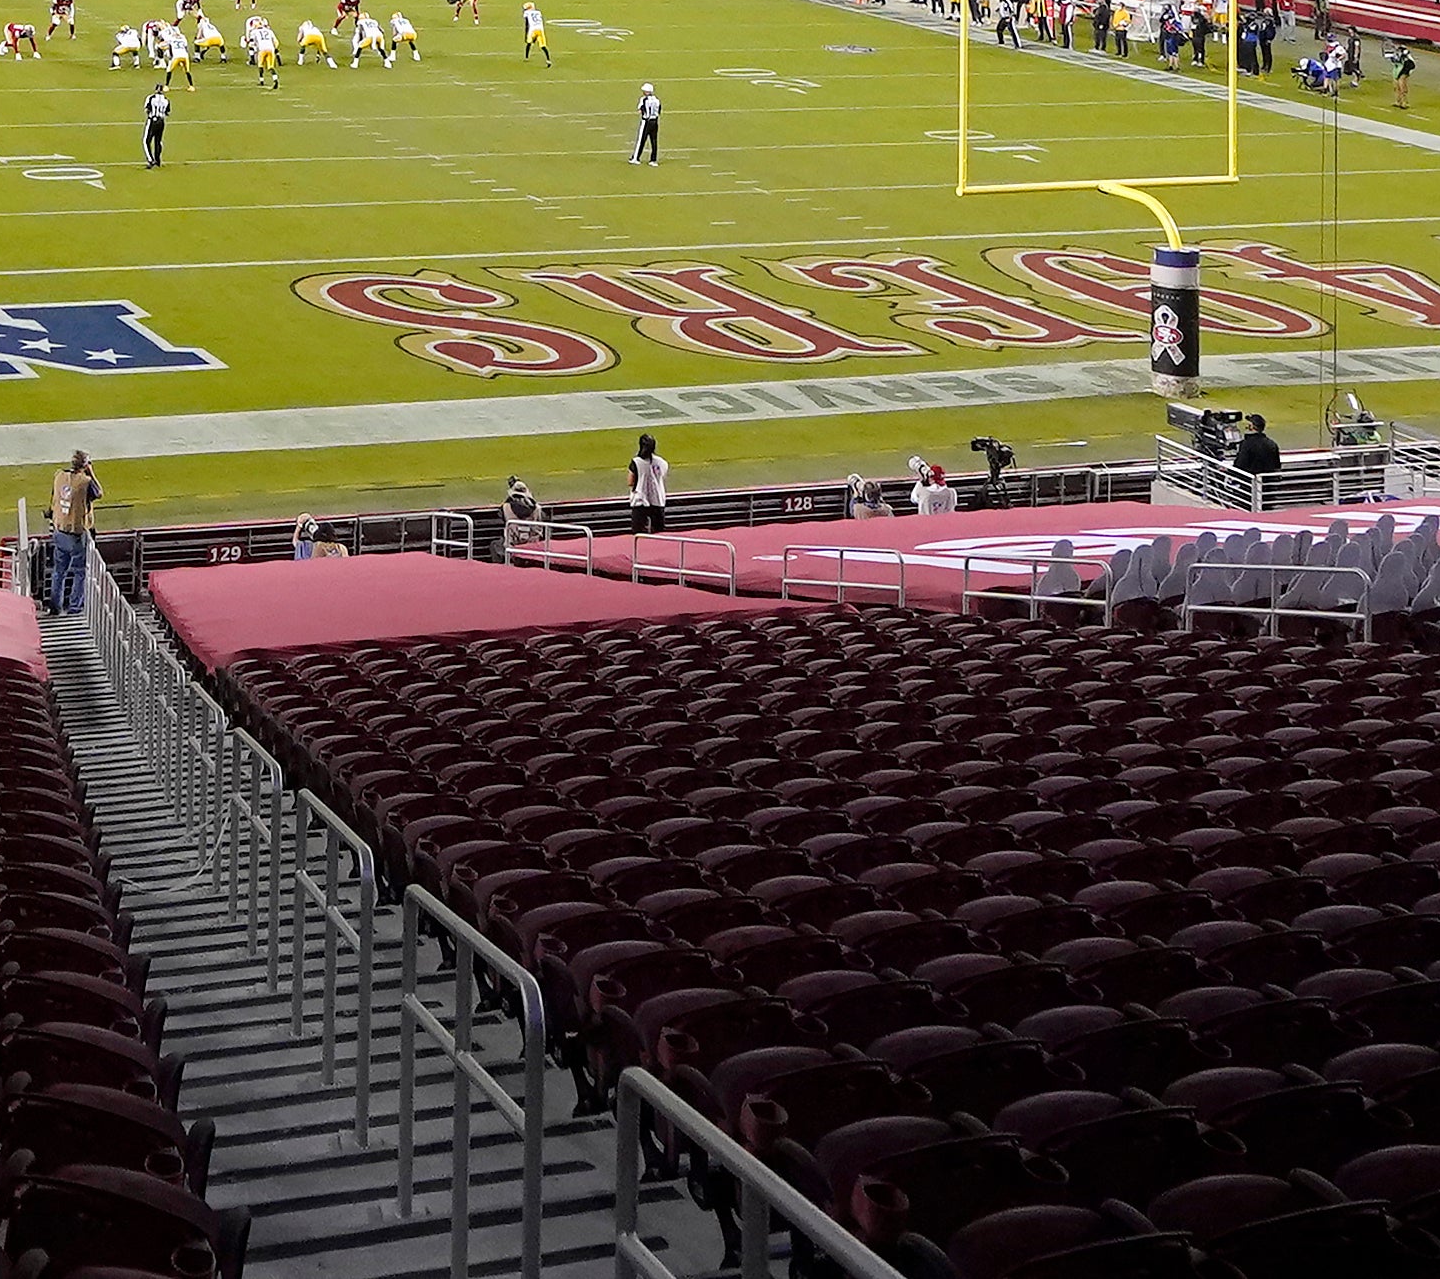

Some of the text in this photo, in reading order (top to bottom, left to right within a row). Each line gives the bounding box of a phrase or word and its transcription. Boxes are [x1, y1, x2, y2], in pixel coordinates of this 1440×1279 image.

[259, 29, 271, 41] 12
[607, 369, 1060, 423] SERVICE
[783, 495, 814, 513] 128
